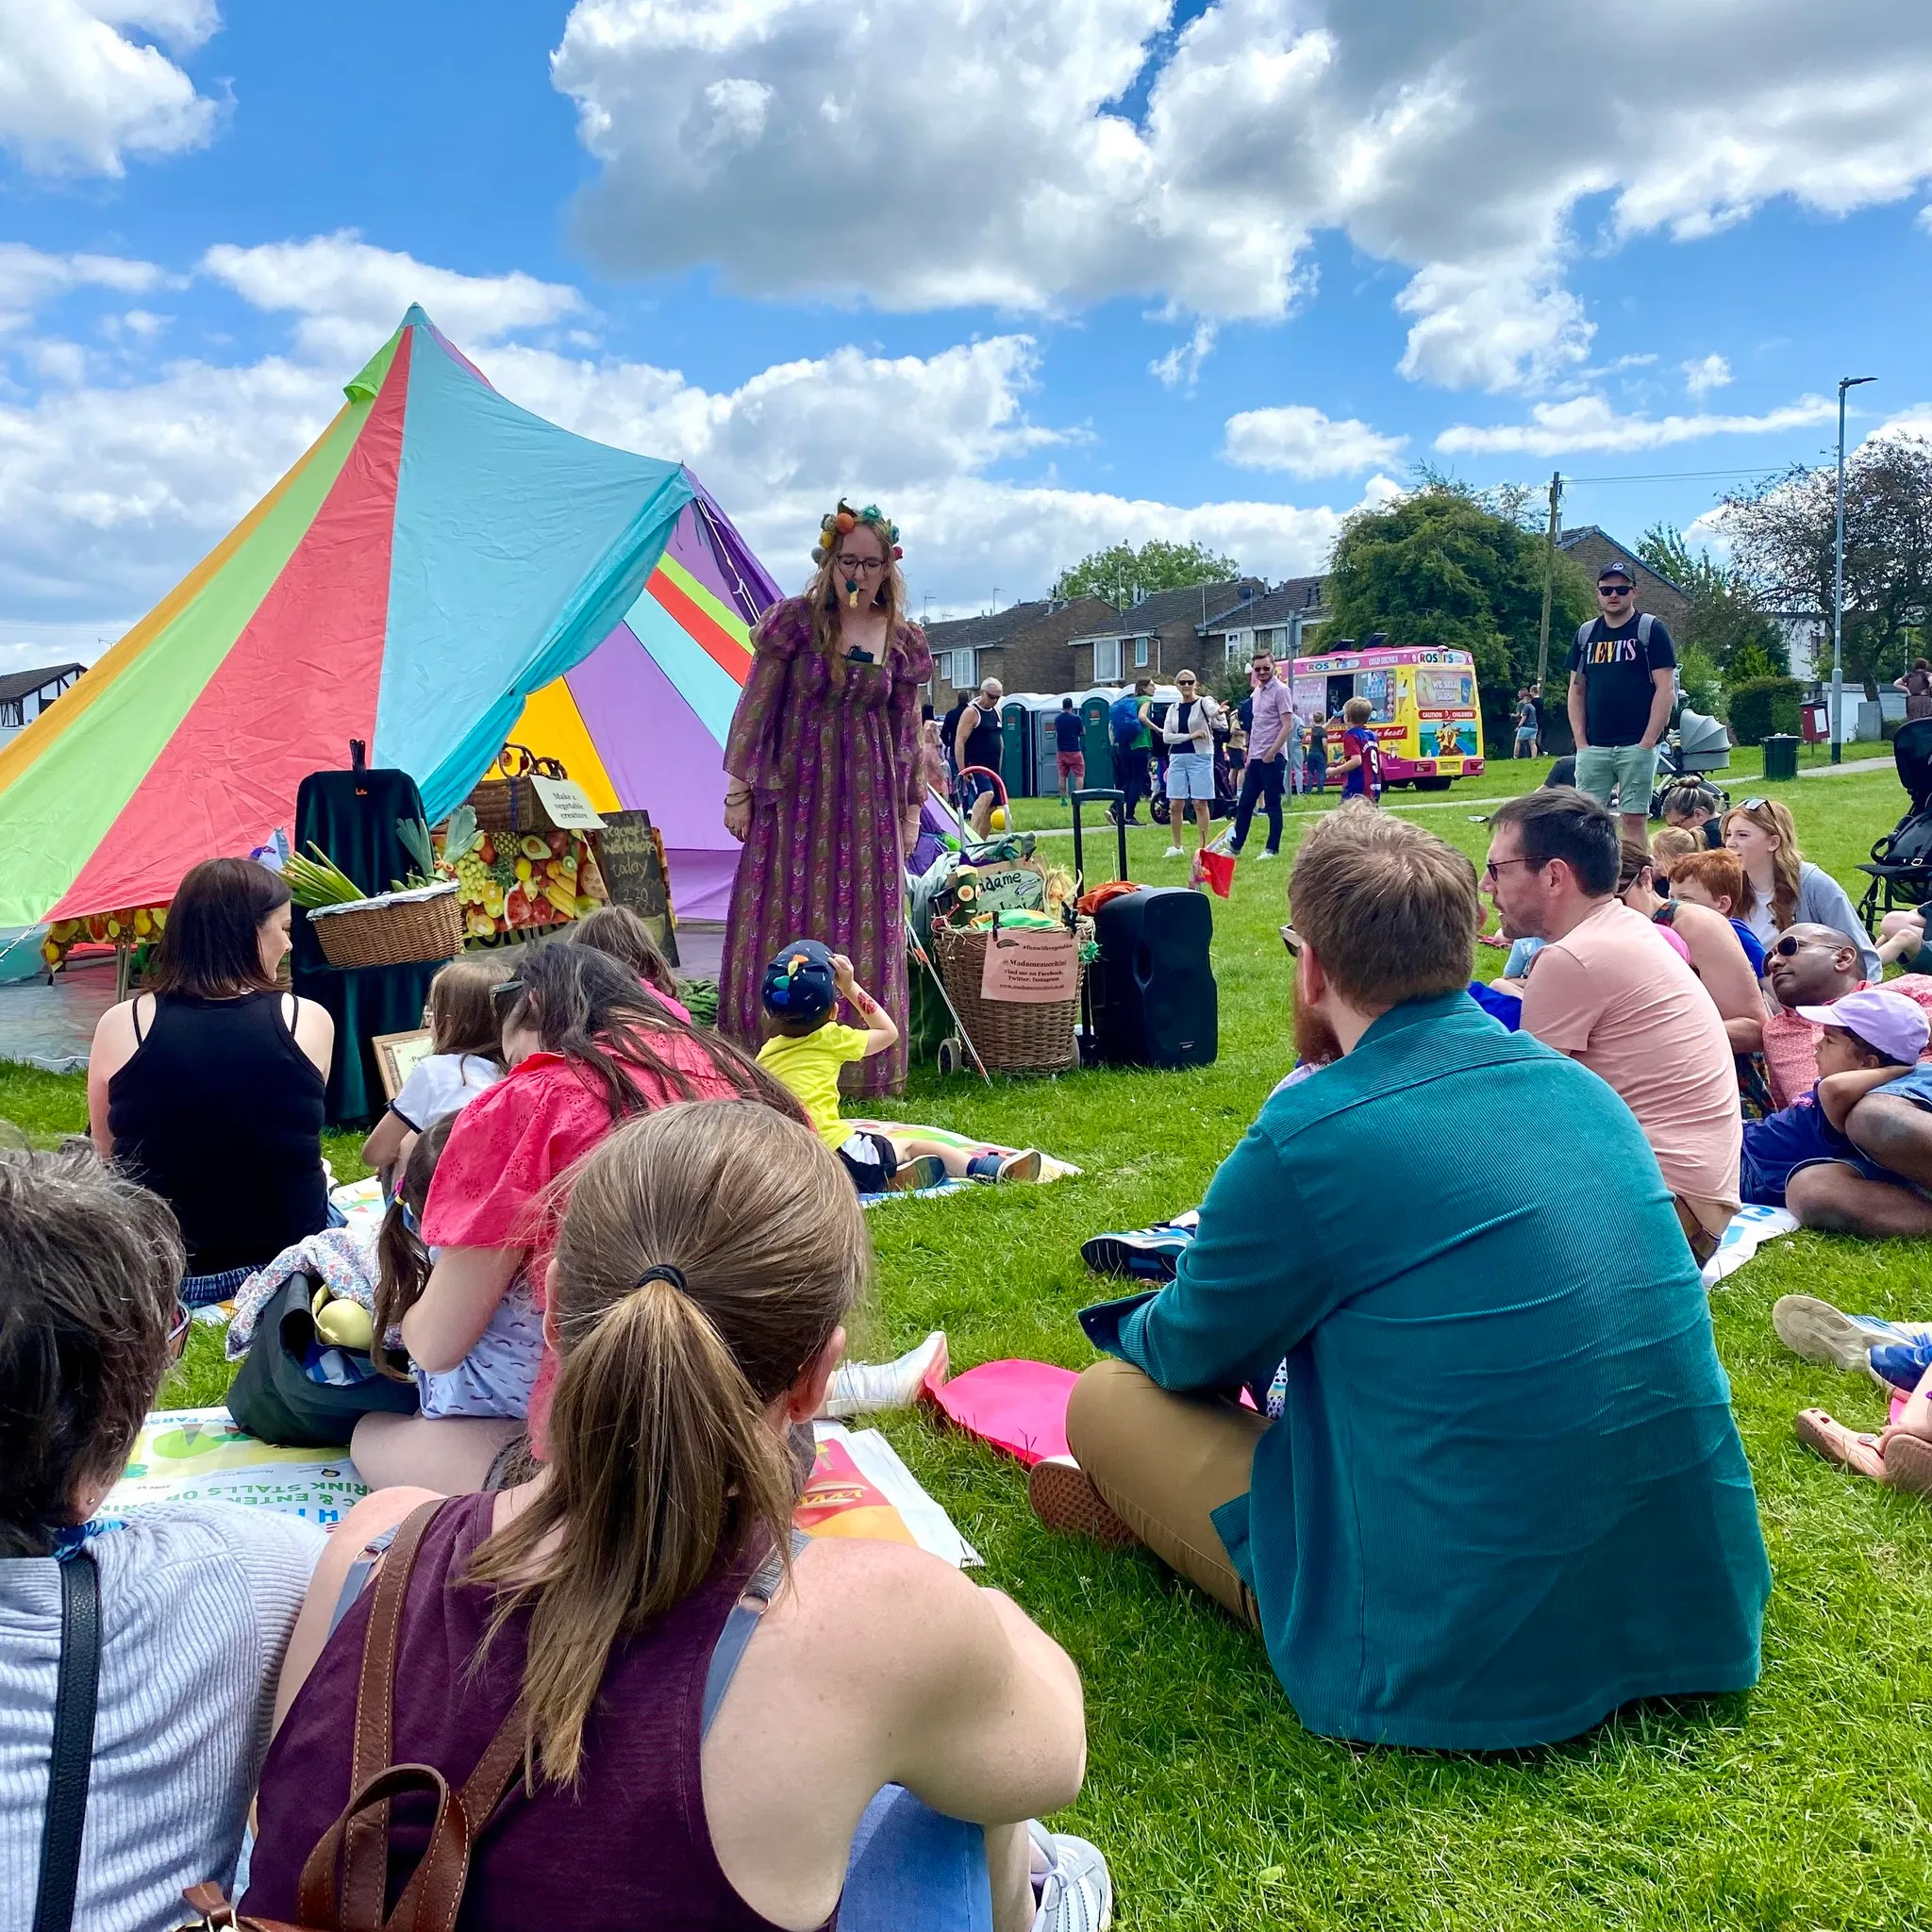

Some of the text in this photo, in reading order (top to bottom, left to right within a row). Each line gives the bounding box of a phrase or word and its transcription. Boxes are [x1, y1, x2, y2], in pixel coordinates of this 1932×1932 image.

[1587, 639, 1638, 664] LEVI'S
[1443, 680, 1457, 690] SELL
[1370, 749, 1378, 774] 9
[609, 853, 648, 879] today
[208, 1484, 301, 1496] STALLS
[309, 1483, 371, 1496] RINK
[318, 1493, 334, 1506] &
